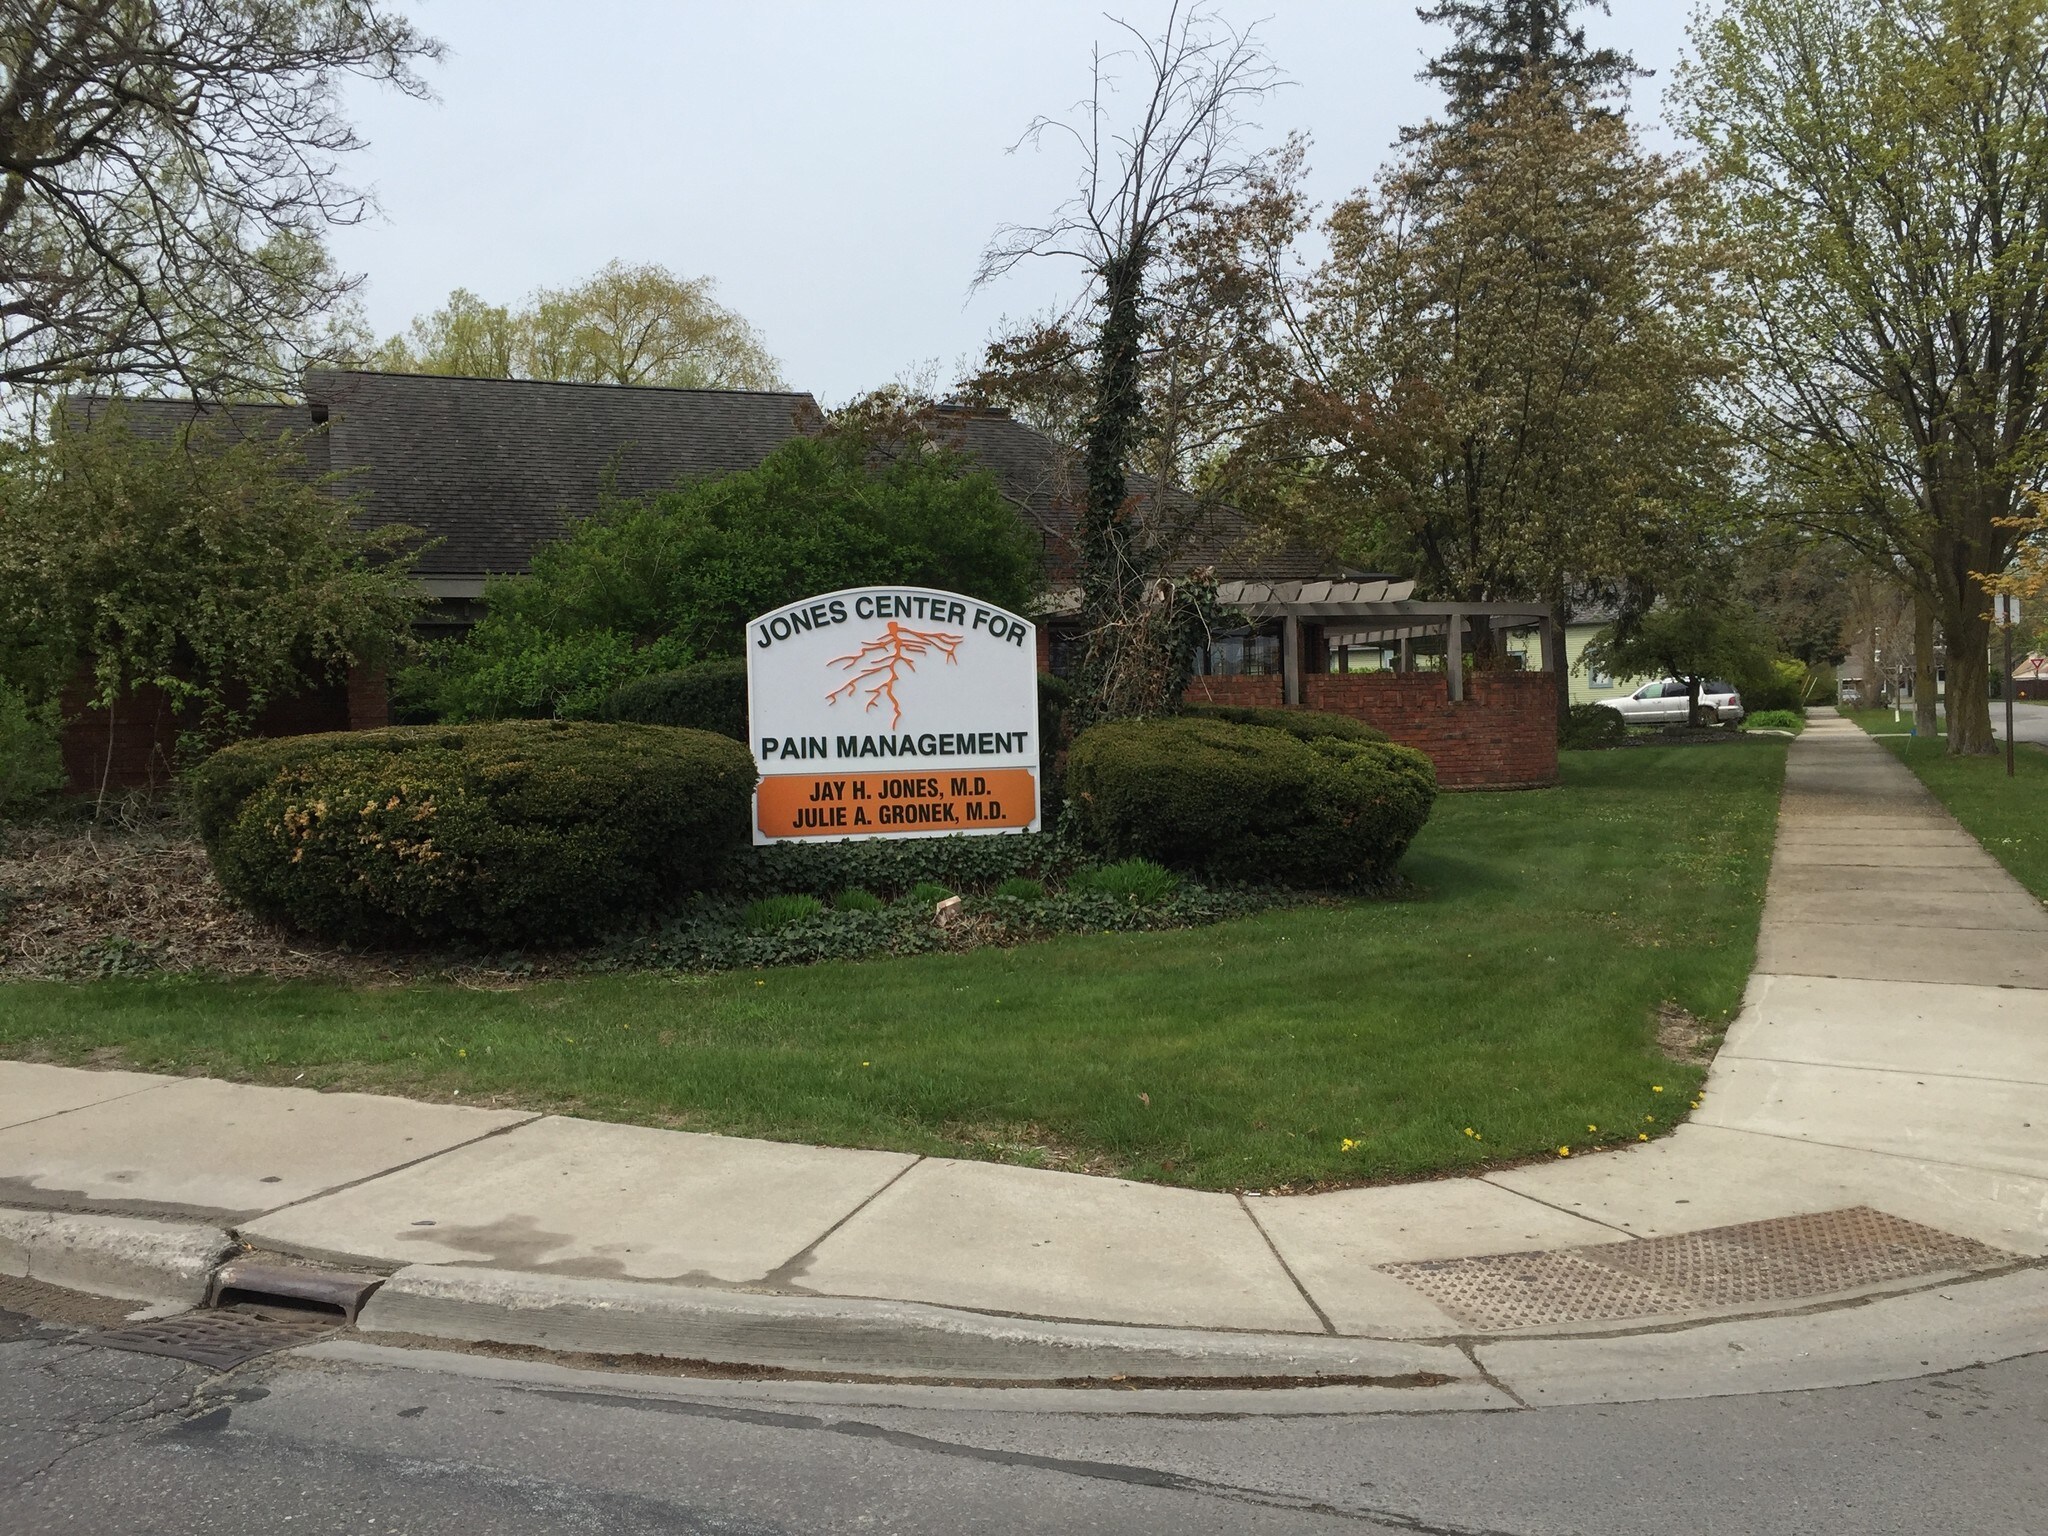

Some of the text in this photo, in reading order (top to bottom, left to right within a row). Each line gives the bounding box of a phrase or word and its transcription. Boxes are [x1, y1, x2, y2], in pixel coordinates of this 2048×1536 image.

[757, 595, 1027, 648] JONES CENTER FOR
[761, 732, 1028, 760] PAIN MANAGEMENT
[810, 777, 991, 801] JAY H. JONES, M.D.
[793, 801, 1006, 828] JULIE A. GRONEK, M.D.
